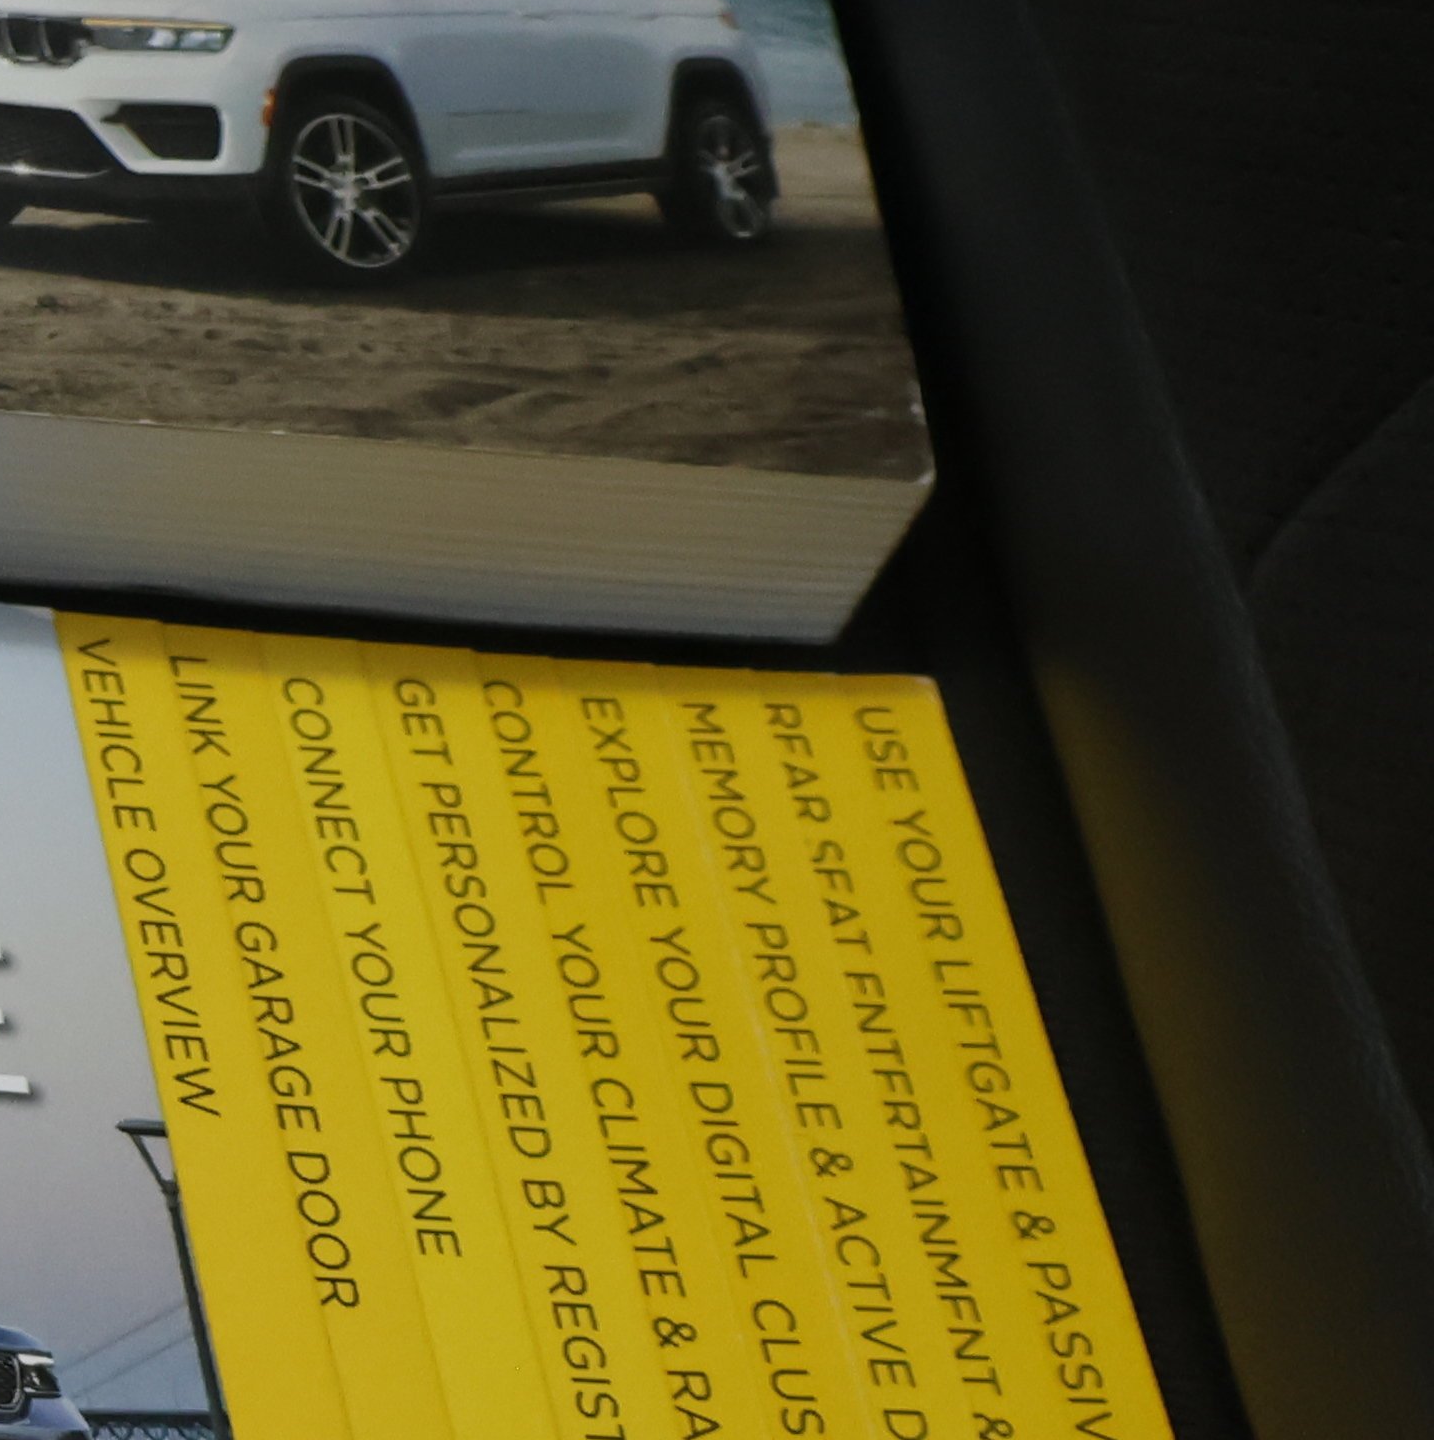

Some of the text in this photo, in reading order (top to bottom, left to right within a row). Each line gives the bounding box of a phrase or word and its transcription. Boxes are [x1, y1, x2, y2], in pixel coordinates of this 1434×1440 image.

[77, 638, 221, 1116] VEHICLE OVERVIEW
[394, 679, 453, 765] GET
[682, 702, 777, 905] MEMORY
[169, 655, 360, 1309] LINK YOUR GARAGE DOOR
[282, 677, 462, 1258] CONNECT YOUR PHONE
[421, 782, 552, 1159] PERSONALIZED
[483, 680, 571, 905] CONTROL
[552, 924, 620, 1060] YOUR
[591, 1077, 685, 1299] CLIMATE
[654, 1316, 697, 1349] &
[580, 696, 678, 908] EXPLORE
[650, 927, 720, 1063] YOUR
[691, 1082, 777, 1279] DIGITAL
[748, 922, 843, 1130] PROFILE
[854, 707, 918, 793] USE
[894, 810, 963, 942] YOUR
[935, 960, 1043, 1193] LIFTGATE
[1013, 1211, 1056, 1240] &
[523, 1177, 575, 1246] BY
[810, 1149, 853, 1177] &
[825, 1197, 916, 1388] ACTIVE
